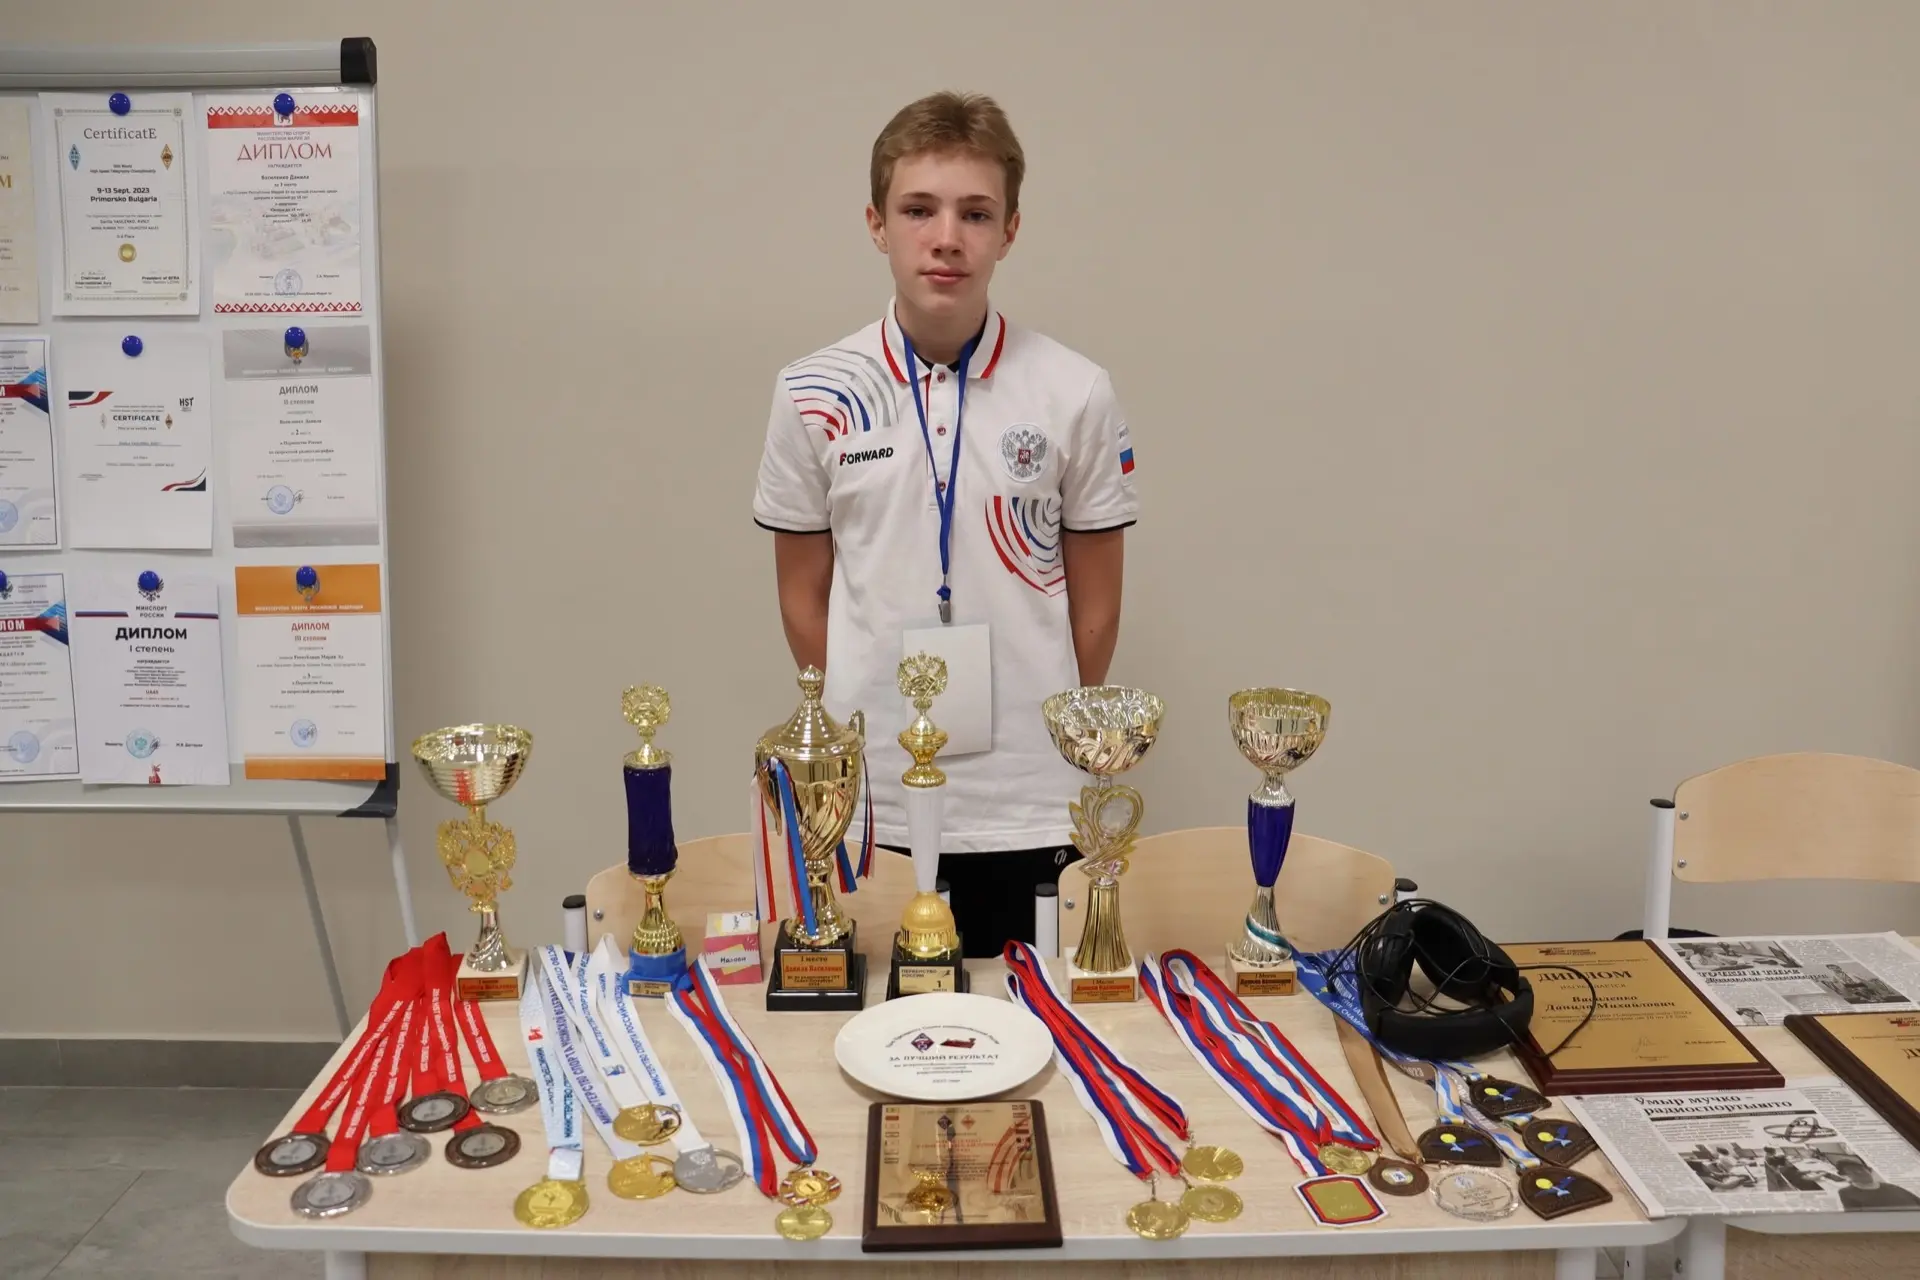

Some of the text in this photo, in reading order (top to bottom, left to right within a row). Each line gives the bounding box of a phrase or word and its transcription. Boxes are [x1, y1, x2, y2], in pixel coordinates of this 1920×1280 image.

[83, 128, 157, 140] CertificatE
[237, 143, 332, 161] ДИПЛОМ
[113, 187, 132, 195] Sept.
[279, 385, 319, 395] ДИПЛОМ
[179, 397, 194, 407] HST
[840, 447, 894, 466] FORWARD
[291, 622, 330, 632] ДИПЛОМ
[115, 627, 187, 641] ДИПЛОМ
[135, 645, 175, 653] степень
[1538, 970, 1632, 982] ДИПЛОМ
[1596, 1002, 1675, 1010] Михайлович
[562, 1044, 584, 1077] СПОРТА
[638, 1051, 667, 1098] МИНИСТЕРСТВО
[575, 1073, 612, 1125] МИНИСТЕРСТВО
[1688, 1094, 1741, 1106] мучко
[562, 1088, 573, 1138] МИНИСТЕРСТВО
